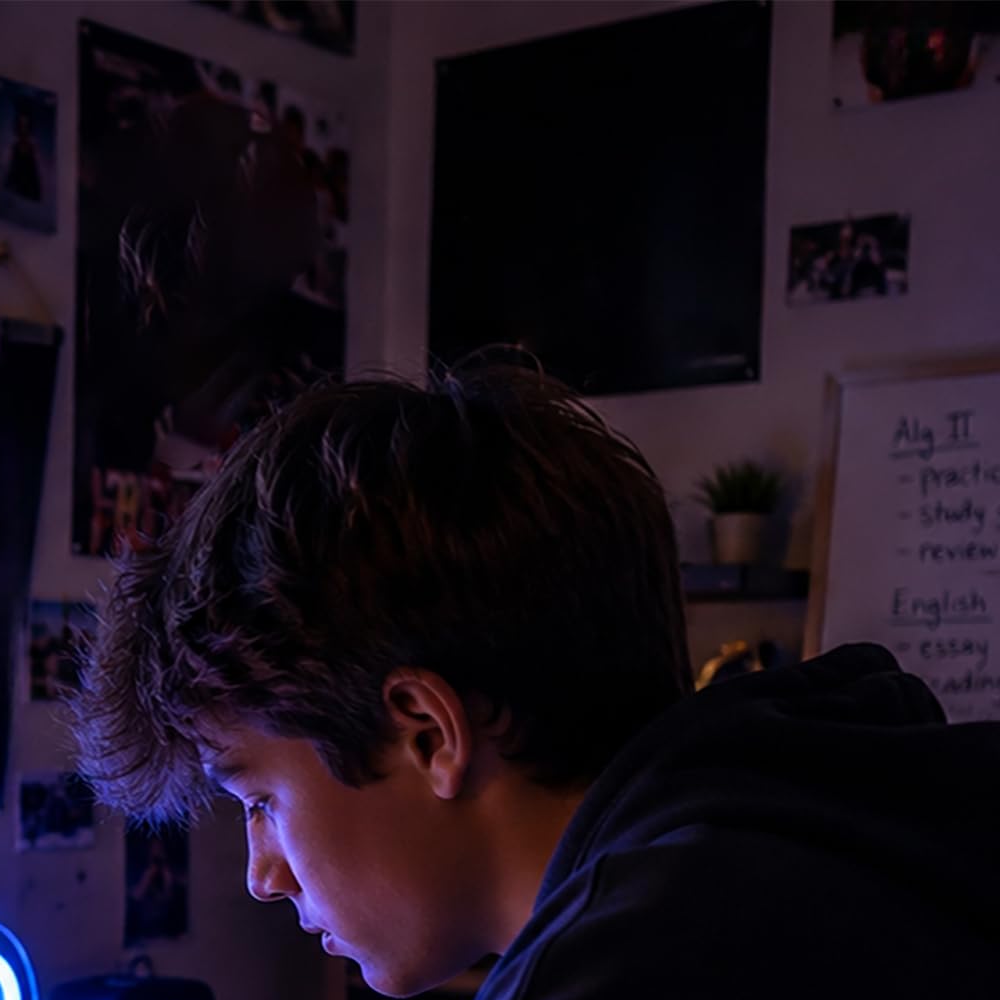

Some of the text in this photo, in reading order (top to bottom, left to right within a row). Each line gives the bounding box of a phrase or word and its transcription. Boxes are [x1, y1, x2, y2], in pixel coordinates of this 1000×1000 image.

[892, 416, 935, 461] Alg
[919, 499, 986, 535] study
[919, 542, 998, 564] review
[892, 588, 987, 631] English
[919, 639, 989, 672] essay
